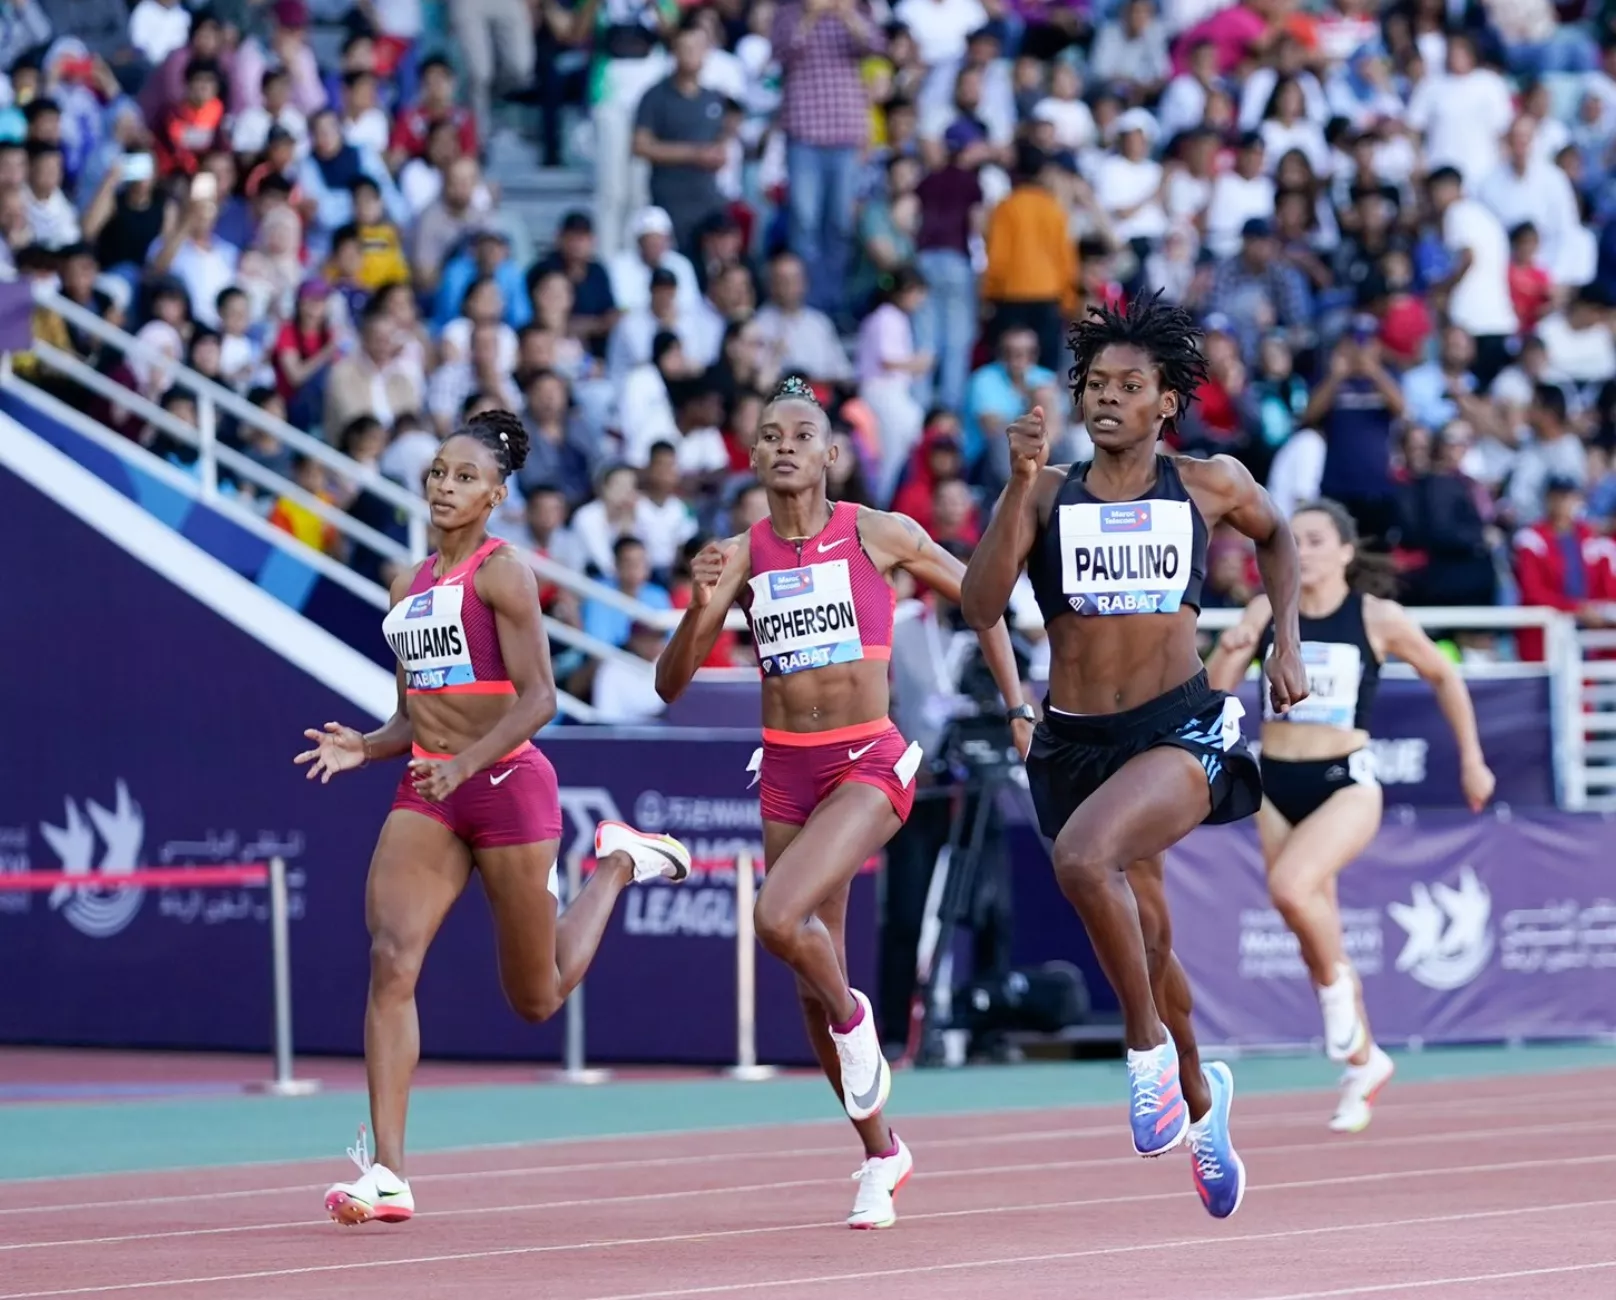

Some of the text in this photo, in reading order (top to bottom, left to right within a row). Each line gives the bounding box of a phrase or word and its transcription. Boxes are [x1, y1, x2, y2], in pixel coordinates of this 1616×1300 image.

[1104, 517, 1136, 525] Telecom
[1111, 510, 1135, 518] Maroc
[1075, 544, 1179, 582] PAULINO
[1097, 594, 1162, 612] RABAT
[754, 601, 855, 645] MCPHERSON
[387, 625, 462, 661] WILLIAMS
[779, 647, 831, 671] RABAT
